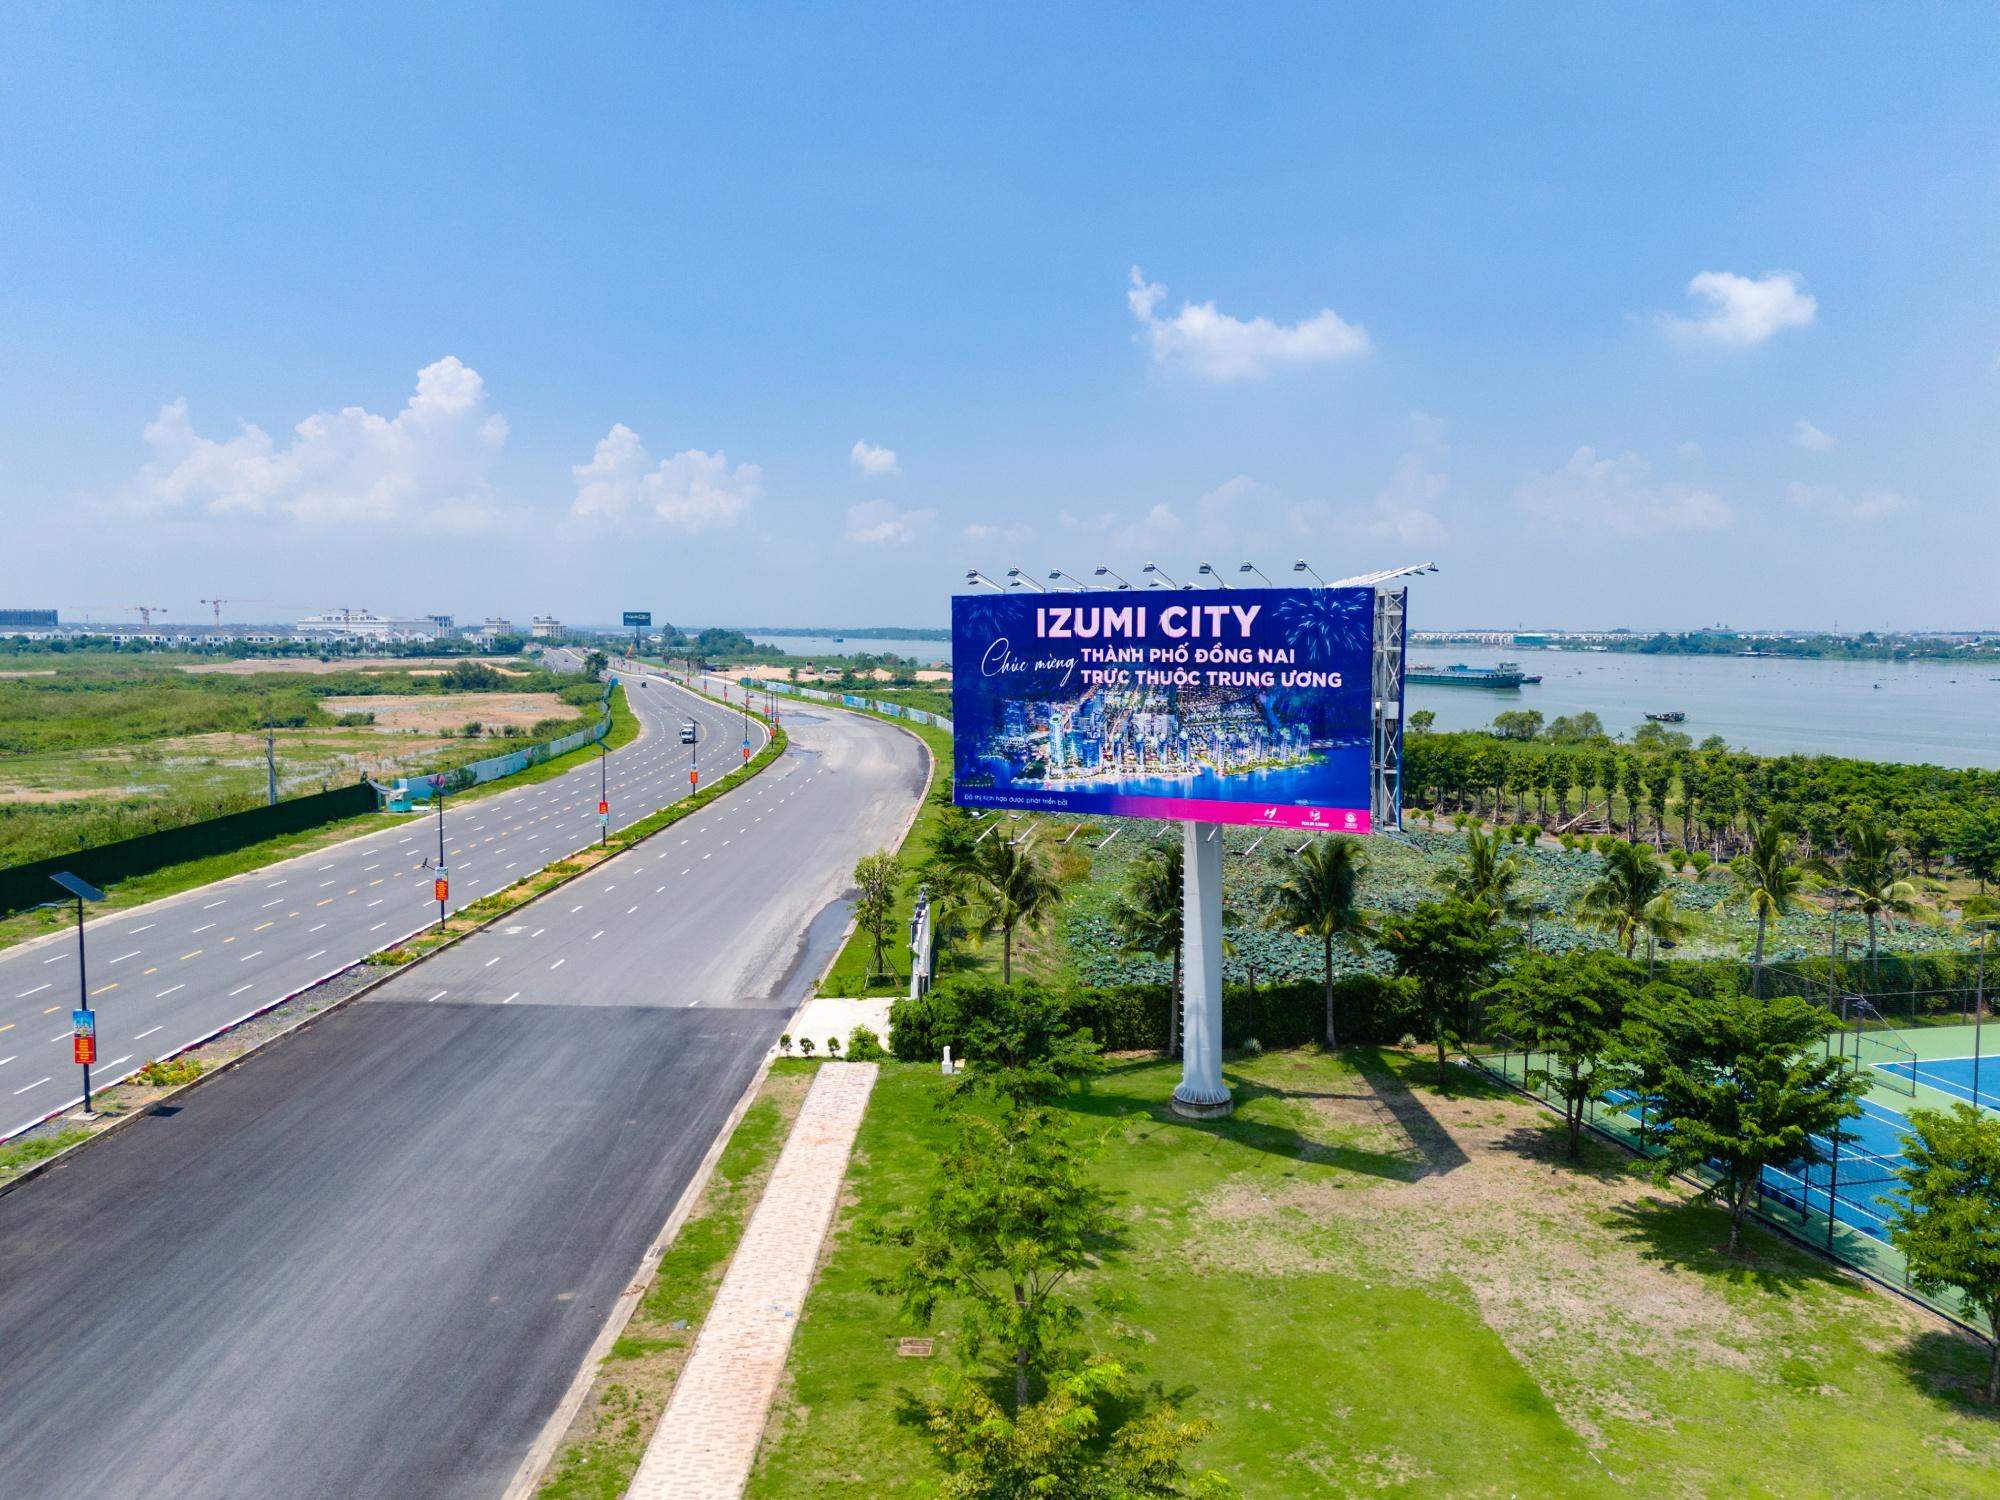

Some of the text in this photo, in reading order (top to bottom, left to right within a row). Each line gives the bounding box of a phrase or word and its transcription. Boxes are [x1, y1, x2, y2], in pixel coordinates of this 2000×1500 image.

[1037, 604, 1261, 638] IZUMI CITY
[981, 637, 1078, 687] Chúc mừng
[1081, 642, 1295, 664] THÀNH PHỐ ĐỒNG NAI
[1081, 667, 1342, 689] TRỰC THUỘC TRUNG ƯƠNG
